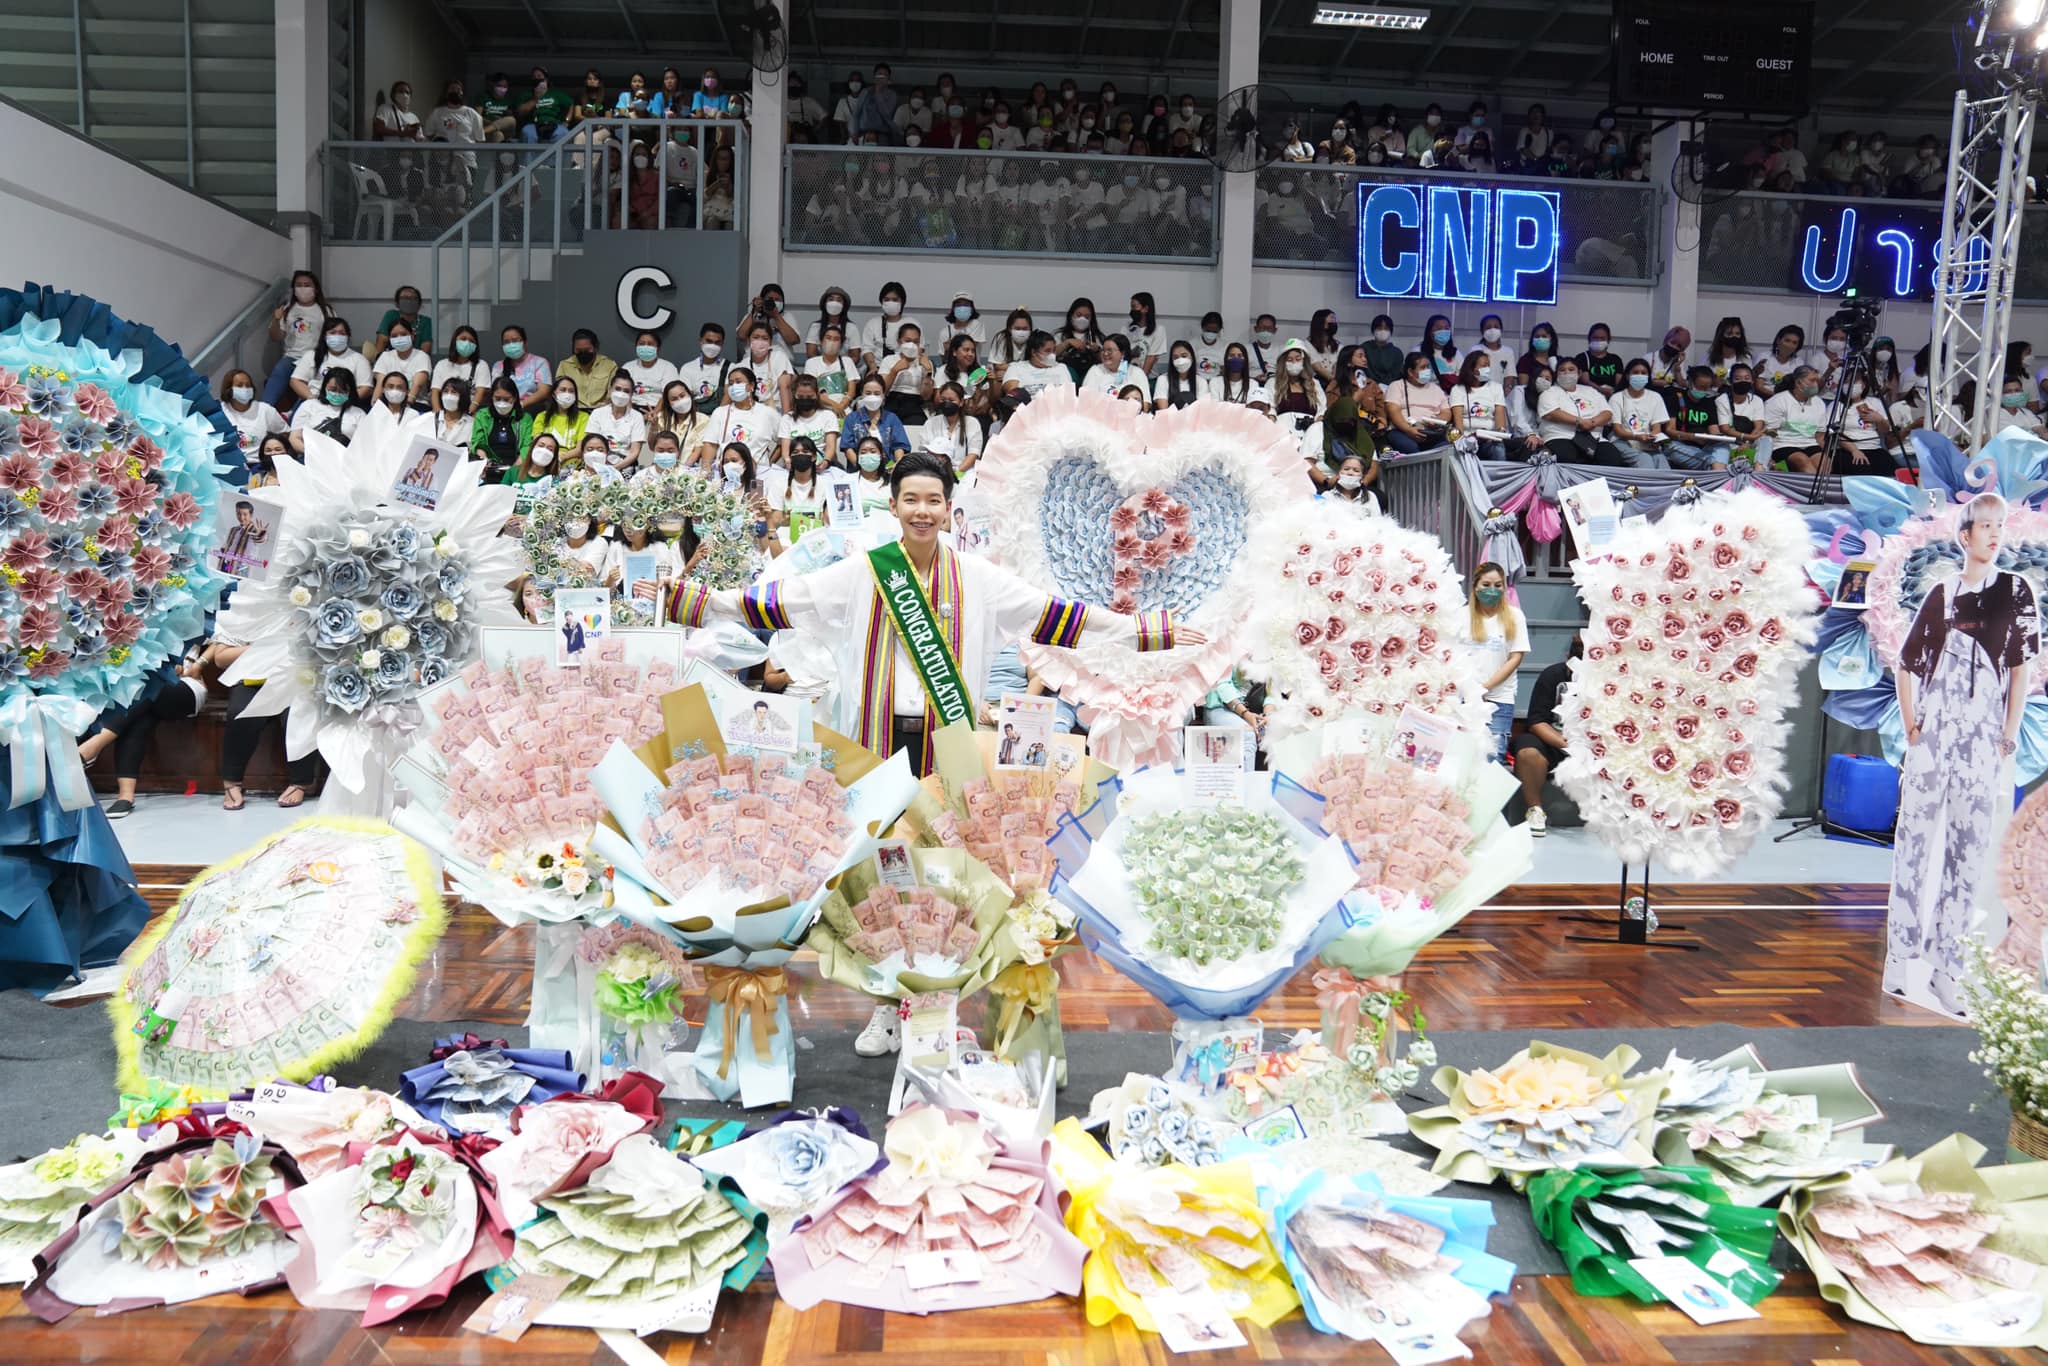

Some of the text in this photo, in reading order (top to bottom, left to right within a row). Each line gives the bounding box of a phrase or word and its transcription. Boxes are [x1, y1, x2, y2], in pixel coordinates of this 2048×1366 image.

[1640, 52, 1674, 64] HOME
[1756, 58, 1793, 70] GUEST
[1362, 185, 1556, 300] CNP
[616, 266, 673, 330] C
[894, 589, 968, 725] CONGRATULATIO
